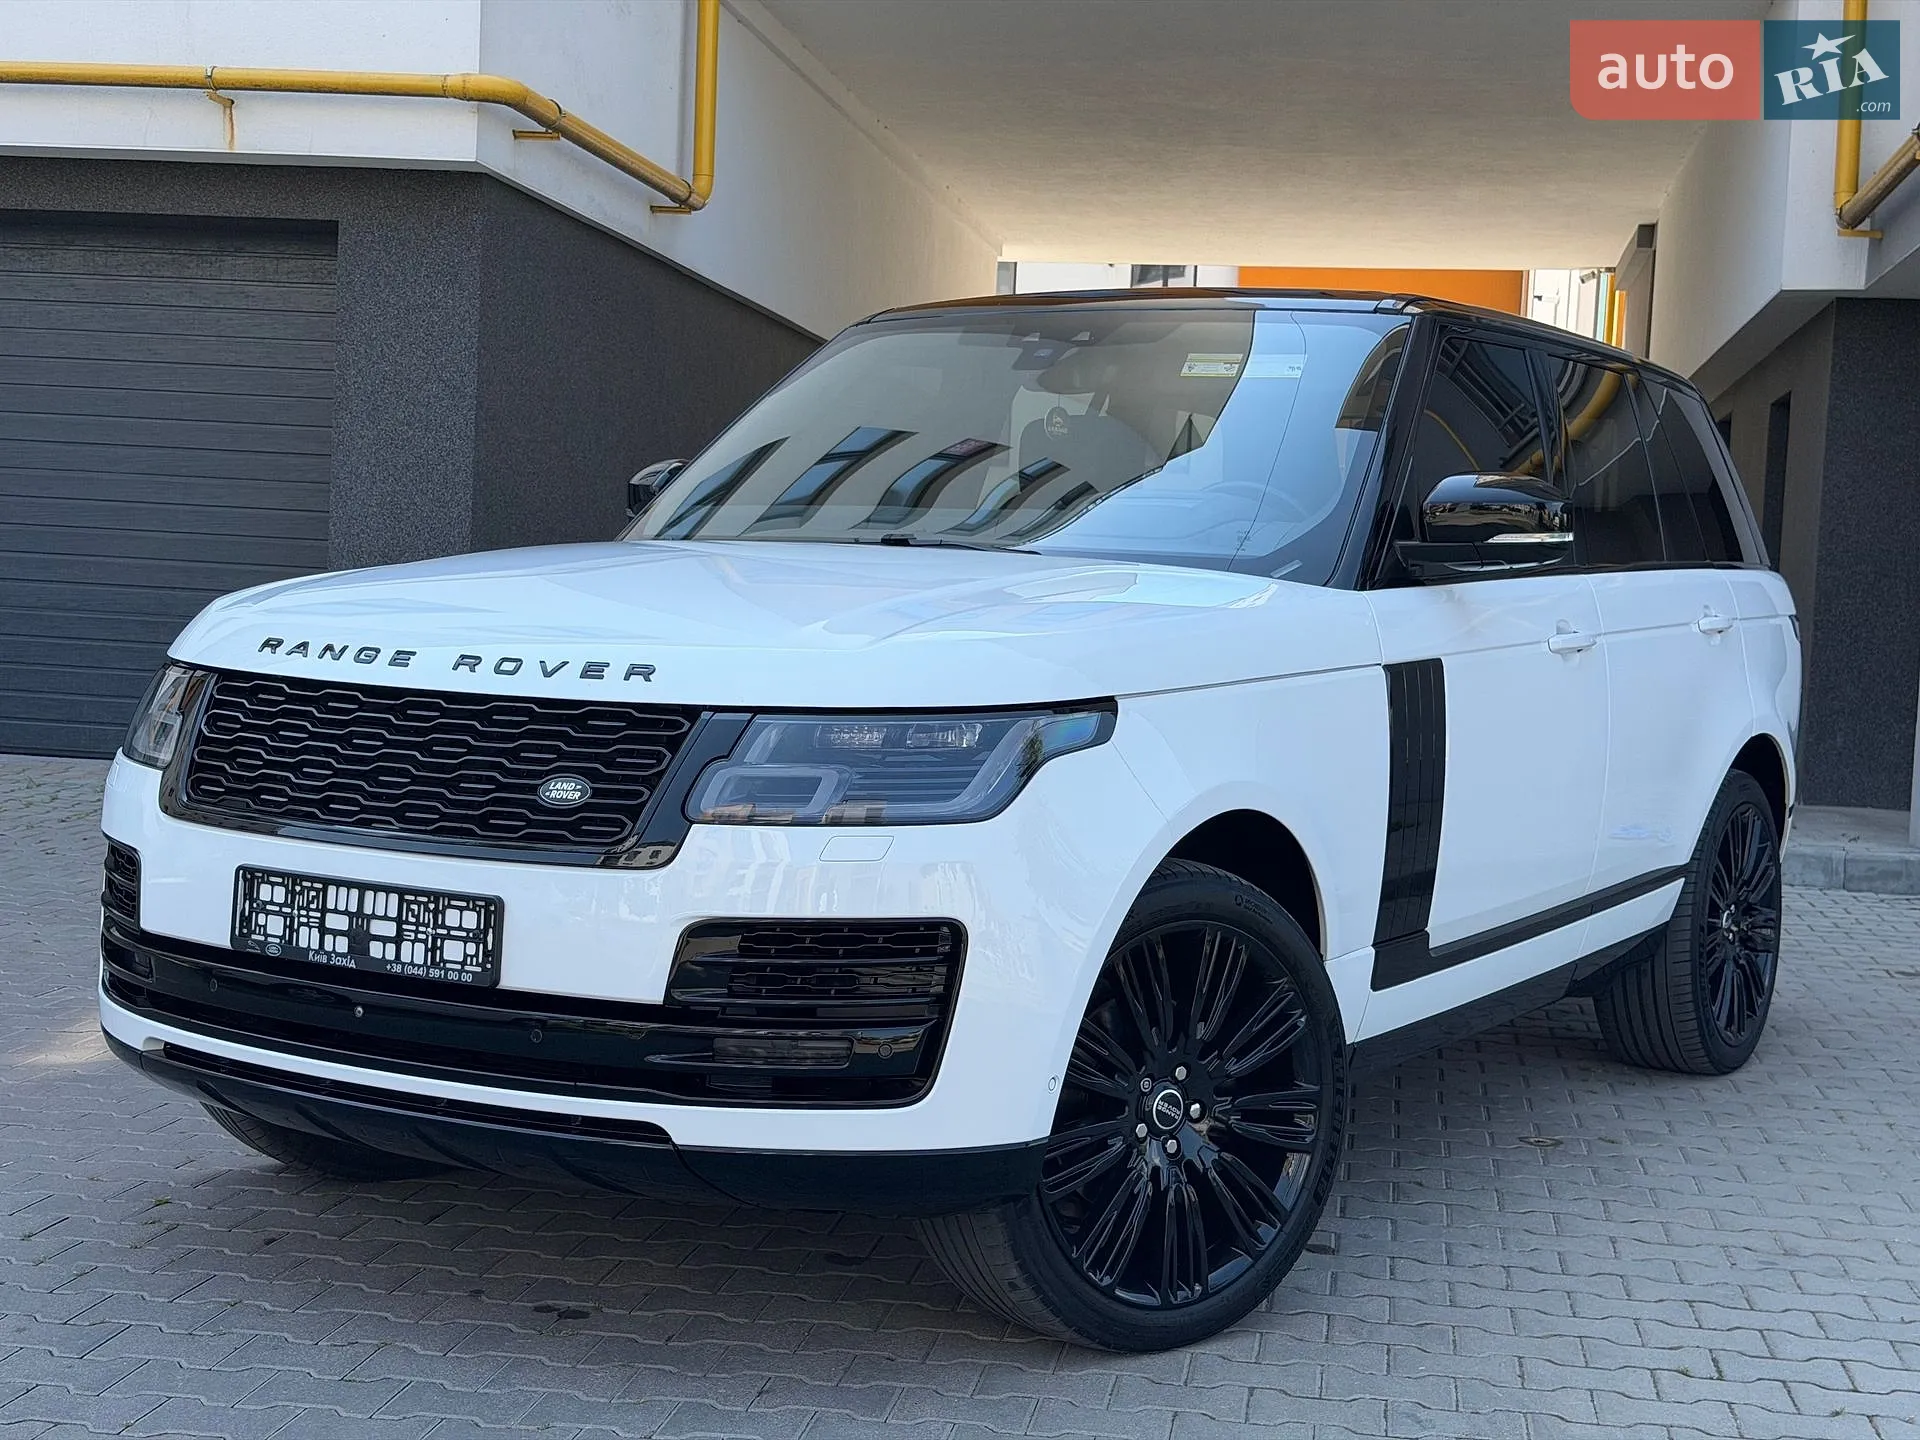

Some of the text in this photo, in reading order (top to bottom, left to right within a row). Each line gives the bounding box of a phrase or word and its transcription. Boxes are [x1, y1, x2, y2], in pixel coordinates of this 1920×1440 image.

[257, 636, 657, 683] RANGE ROVER
[548, 781, 576, 791] LAND
[549, 789, 582, 800] ROVER
[308, 949, 328, 963] Київ
[386, 962, 473, 983] +38 (044) 591 00 00
